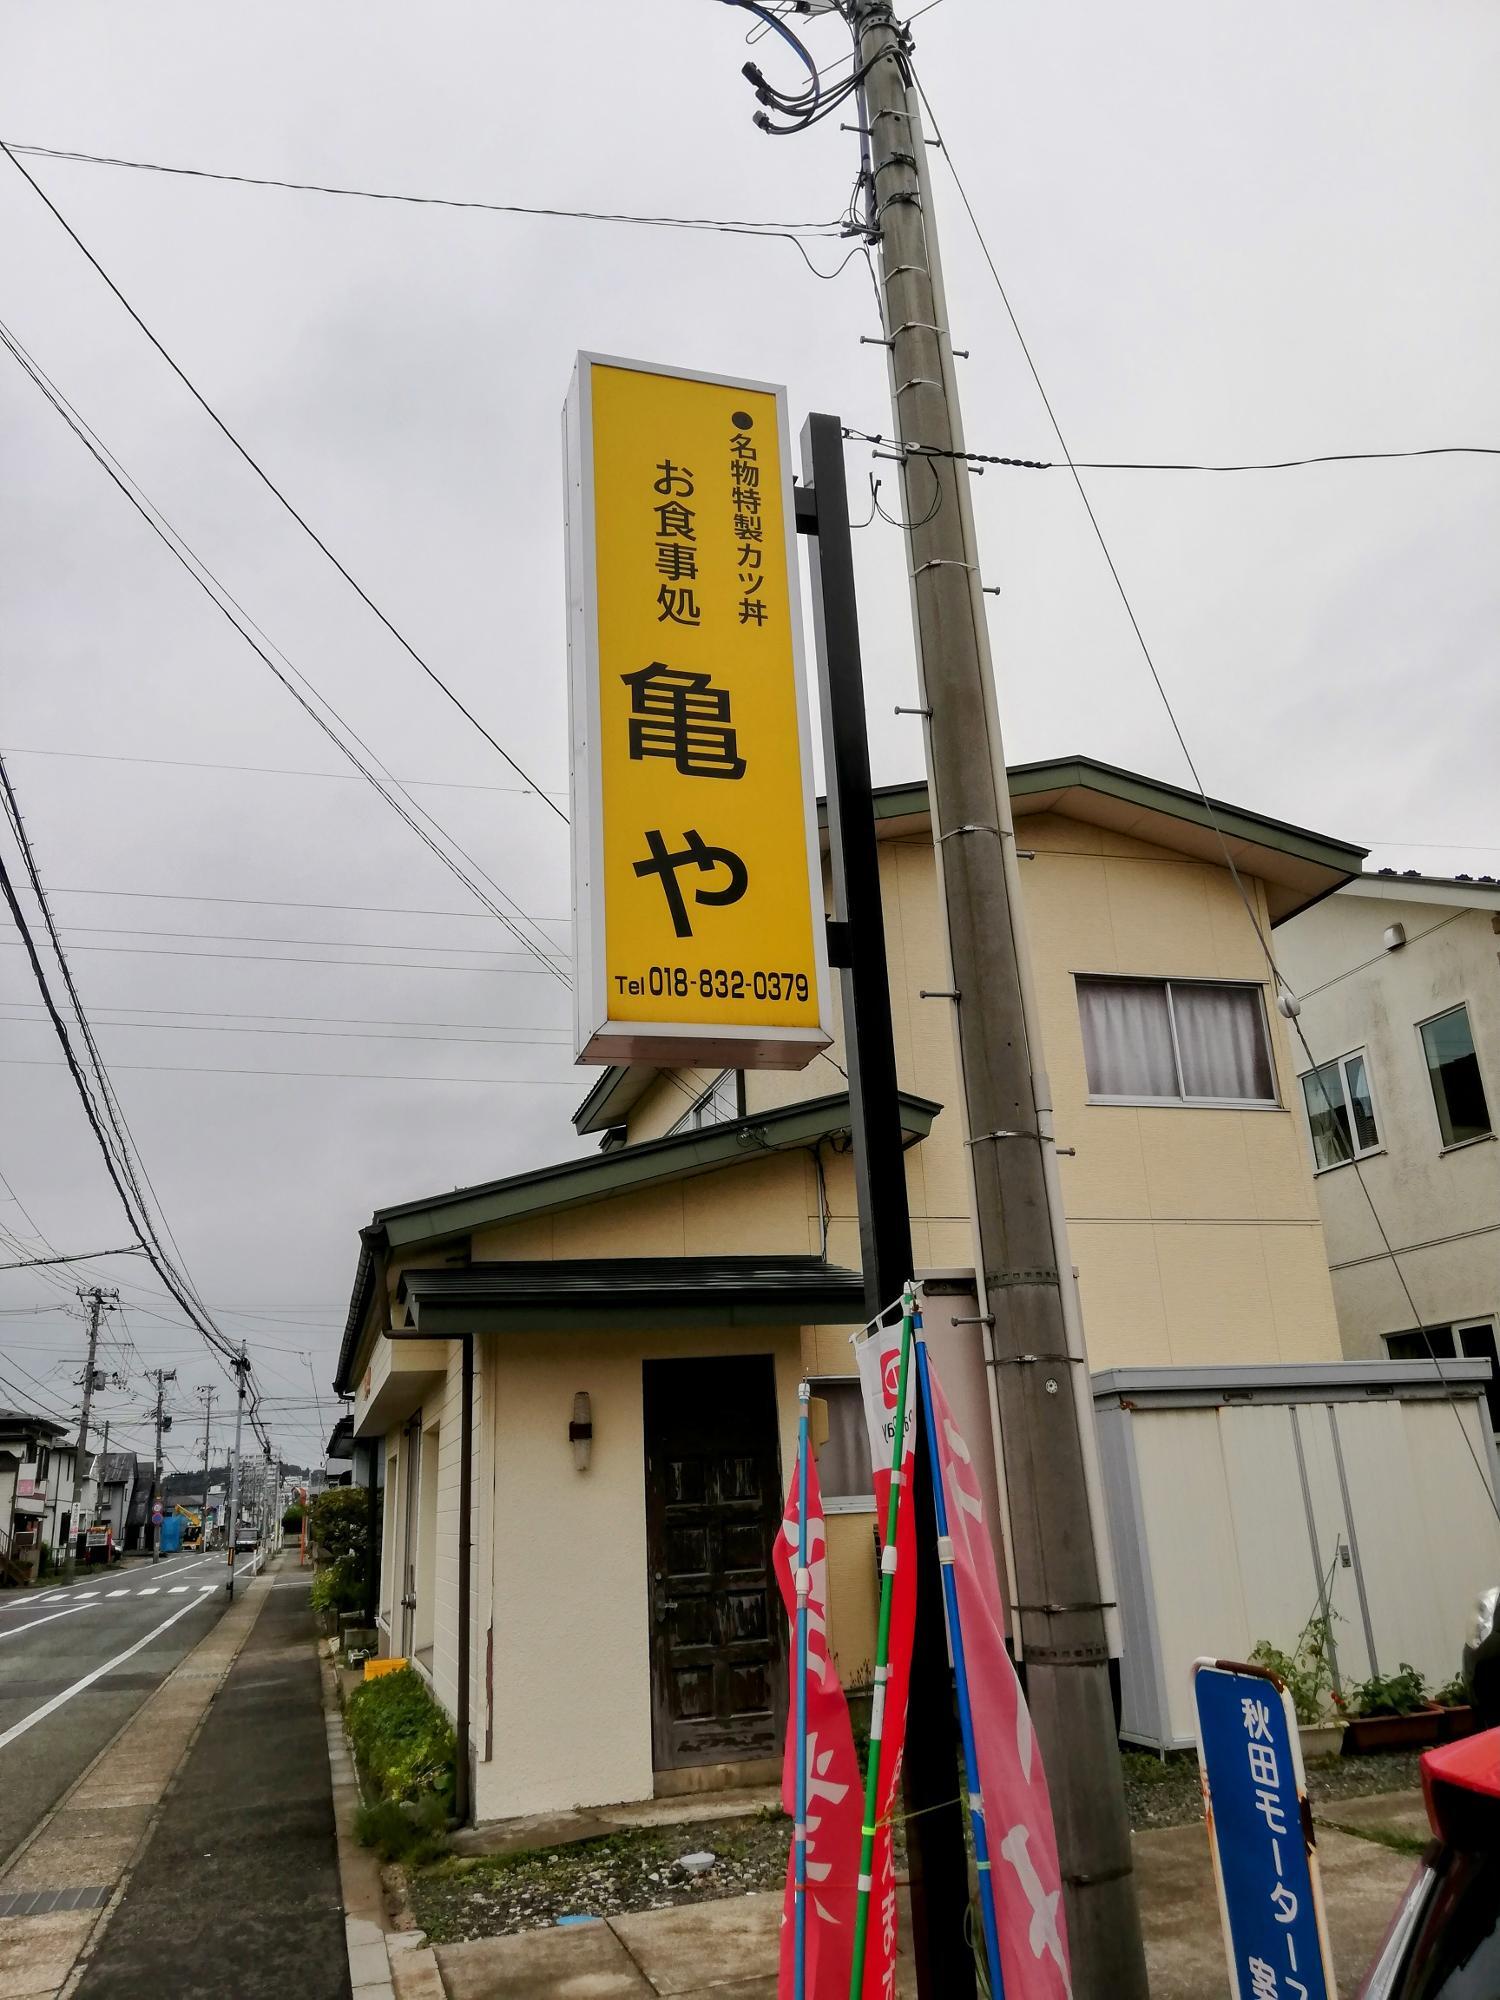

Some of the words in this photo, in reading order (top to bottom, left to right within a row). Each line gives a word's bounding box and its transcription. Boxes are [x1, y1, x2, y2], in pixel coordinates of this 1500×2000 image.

[653, 459, 700, 626] お食事処
[620, 661, 747, 938] 亀や
[615, 975, 645, 996] Tel
[648, 966, 809, 1002] 018-832-0379
